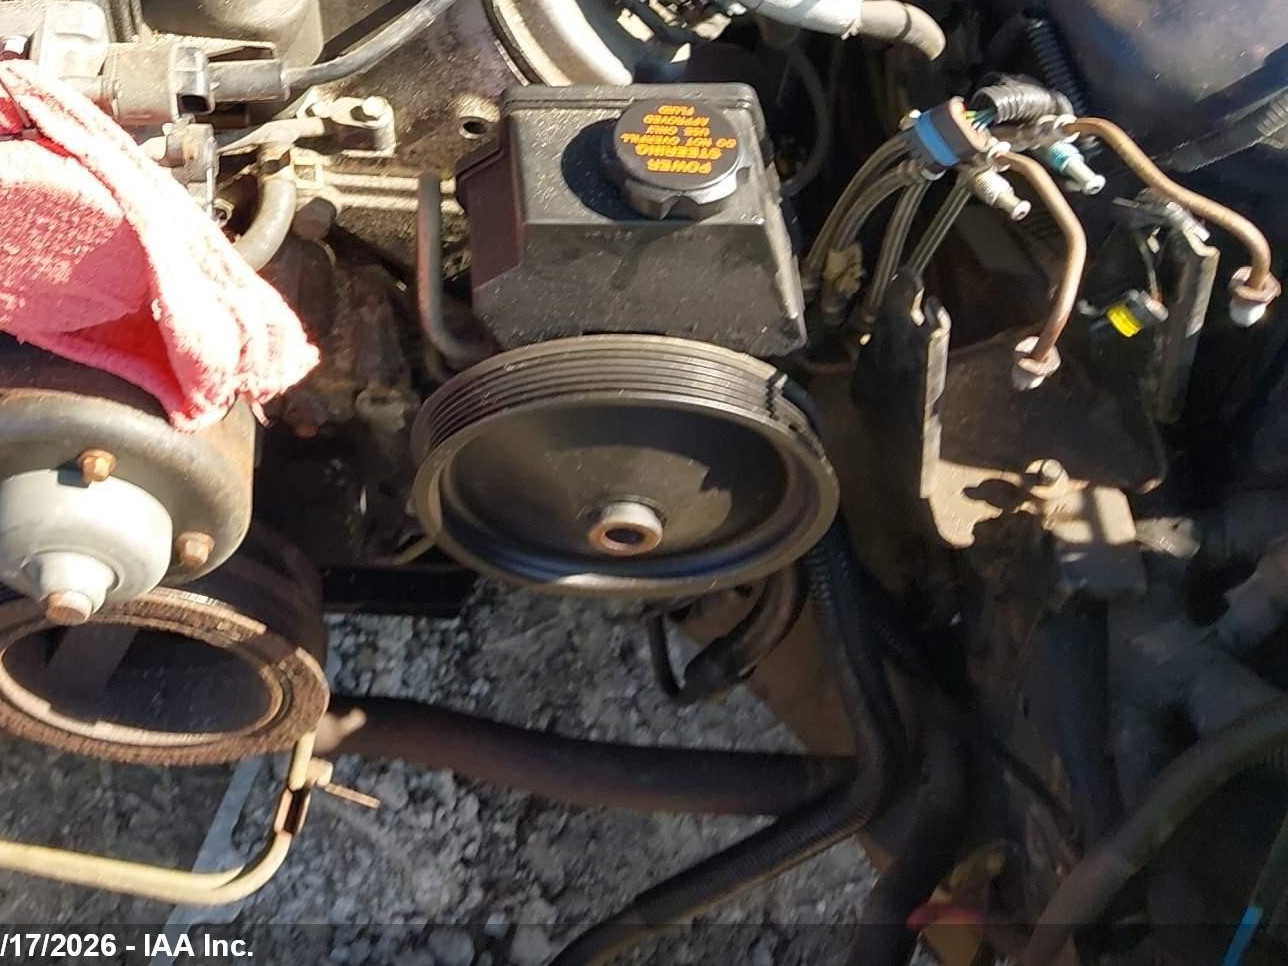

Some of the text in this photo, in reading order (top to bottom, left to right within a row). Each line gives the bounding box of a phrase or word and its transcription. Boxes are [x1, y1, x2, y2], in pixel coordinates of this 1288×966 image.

[657, 105, 695, 116] FLUID
[643, 114, 710, 127] APPROVED
[646, 125, 710, 136] USE ONLY
[685, 136, 713, 147] NOT
[716, 138, 737, 149] DO
[635, 144, 722, 160] STEERING
[647, 159, 712, 174] POWER
